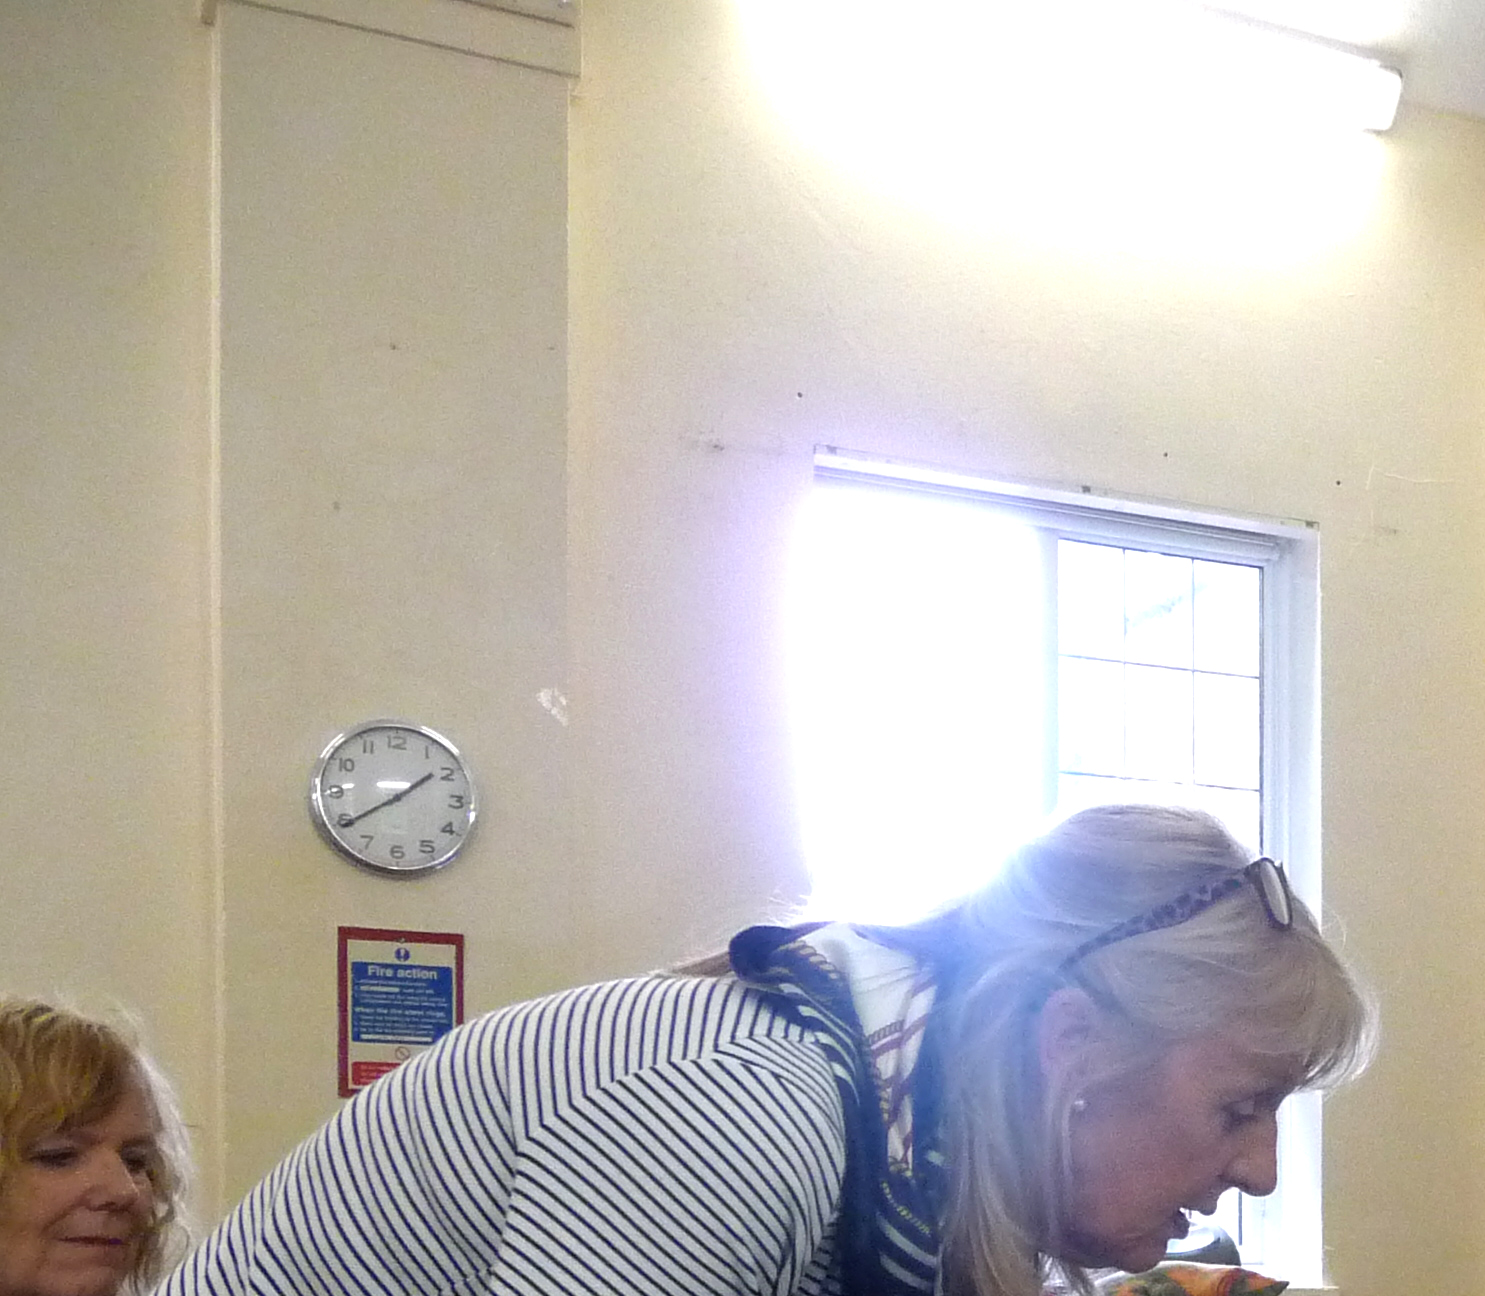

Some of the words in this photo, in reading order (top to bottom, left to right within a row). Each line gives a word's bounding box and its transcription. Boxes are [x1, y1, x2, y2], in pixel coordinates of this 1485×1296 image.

[362, 740, 374, 754] 11
[387, 735, 407, 750] 12
[425, 745, 430, 759] 1
[338, 758, 355, 772] 10
[440, 767, 455, 781] 2
[329, 784, 344, 799] 9
[448, 795, 464, 809] 3
[441, 821, 456, 836] 4
[360, 835, 374, 850] 7
[419, 840, 436, 854] 5
[390, 845, 405, 859] 6
[367, 965, 394, 977] Fire
[396, 968, 438, 980] action
